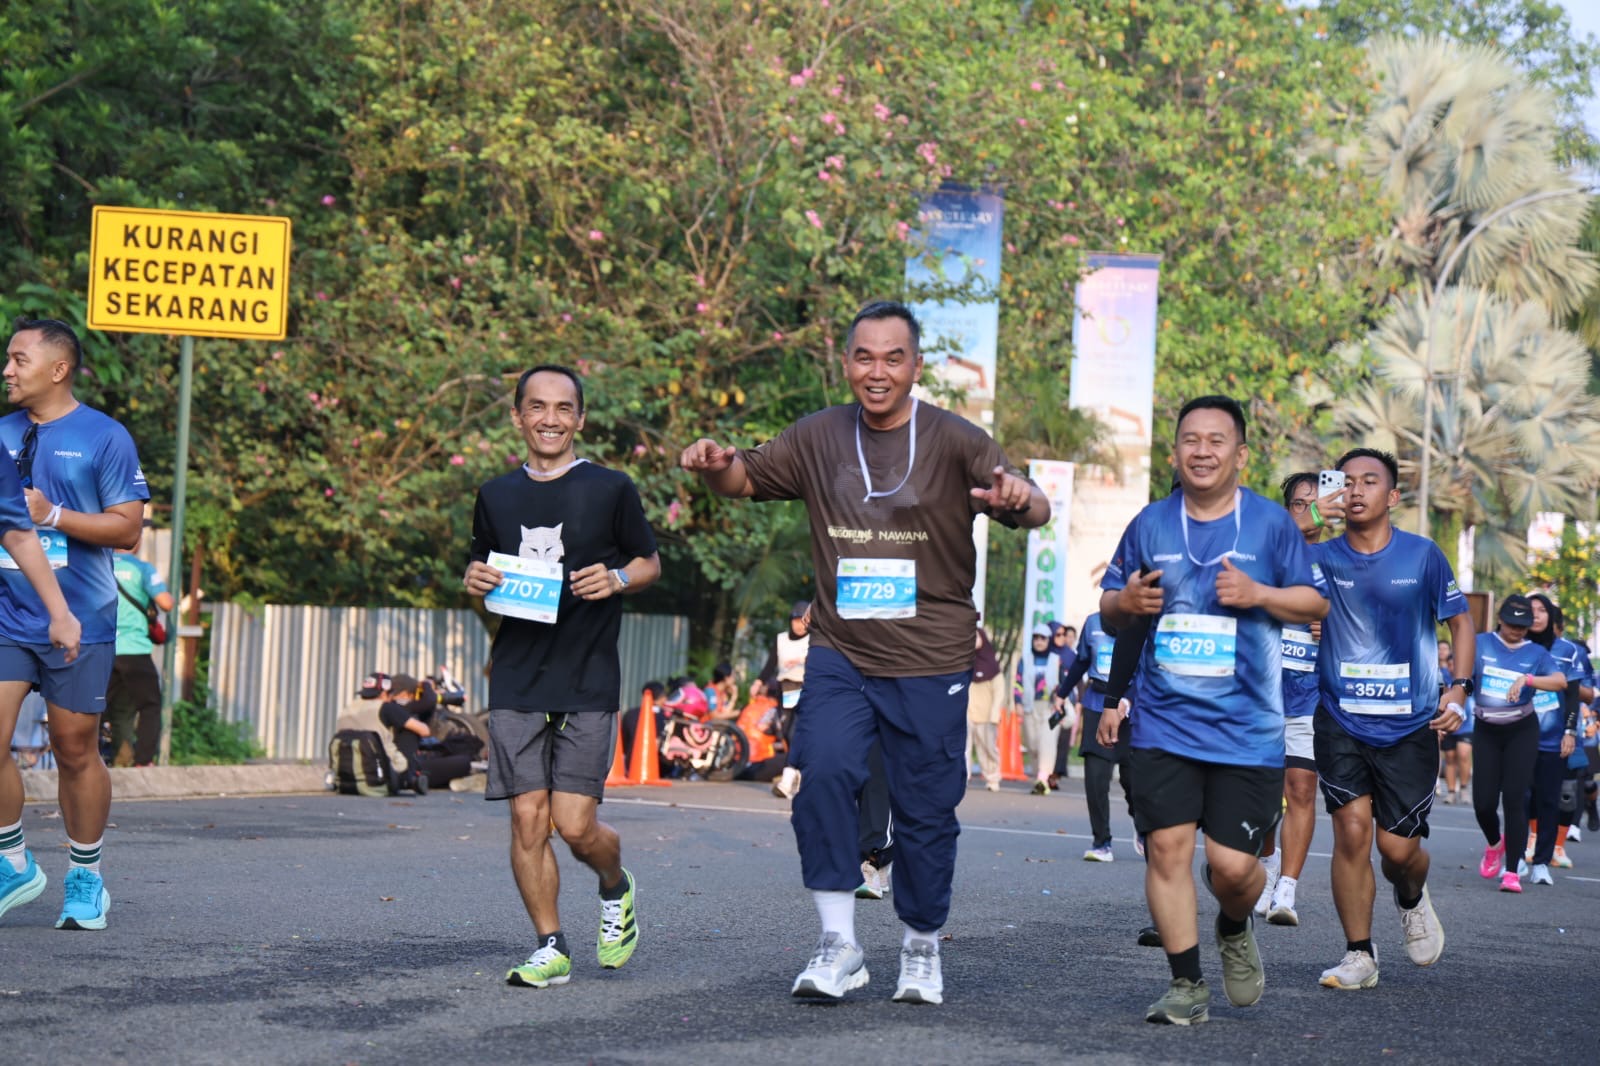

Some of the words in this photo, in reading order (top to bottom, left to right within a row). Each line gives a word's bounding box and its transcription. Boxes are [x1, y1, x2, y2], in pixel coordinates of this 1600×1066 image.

[123, 224, 259, 255] KURANGI
[103, 257, 274, 290] KECEPATAN
[106, 291, 269, 324] SEKARANG
[878, 530, 928, 541] NAWANA
[499, 578, 544, 599] 7707
[851, 582, 896, 600] 7729
[1169, 638, 1216, 656] 6279
[1355, 683, 1396, 698] 3574
